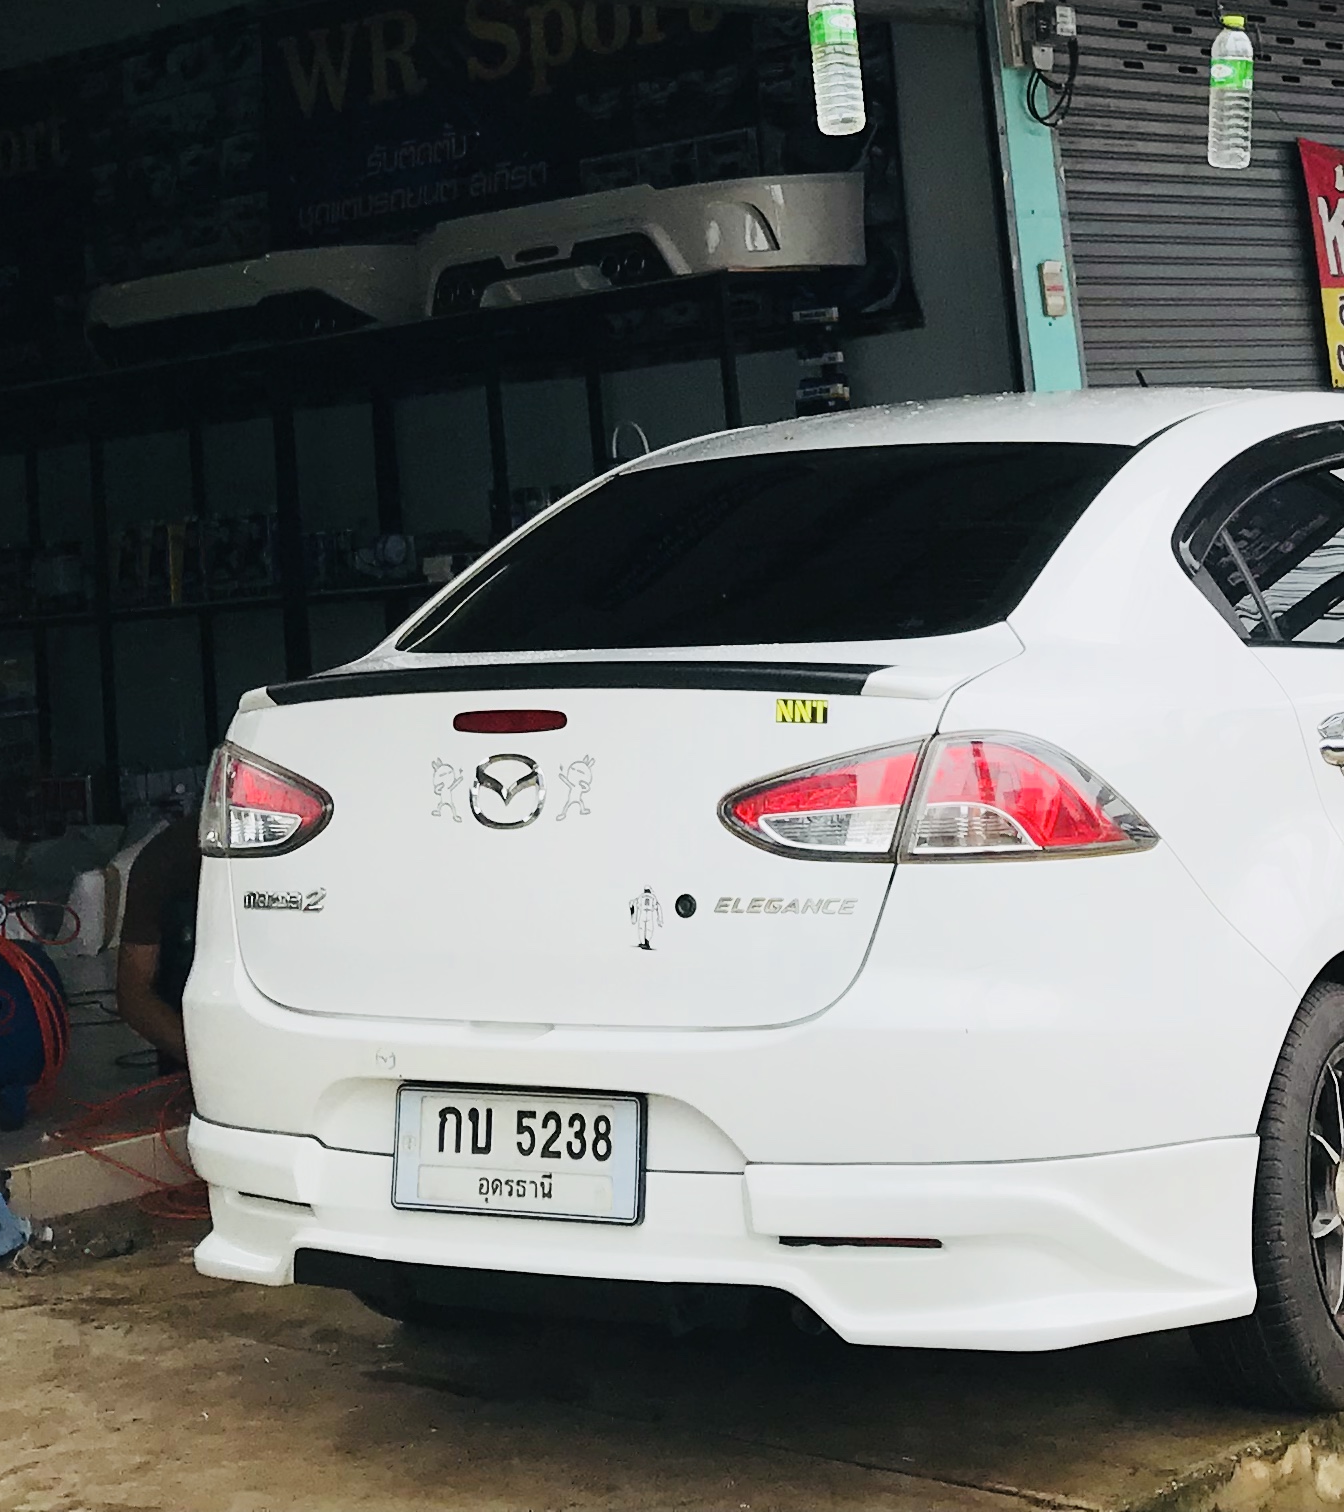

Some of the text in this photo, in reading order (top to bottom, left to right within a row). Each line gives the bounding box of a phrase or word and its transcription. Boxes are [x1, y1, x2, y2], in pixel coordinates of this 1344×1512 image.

[776, 698, 828, 724] NNT
[714, 896, 859, 915] ELEGANCE
[438, 1106, 613, 1162] กบ 5238
[478, 1172, 553, 1204] อุดรธานี
